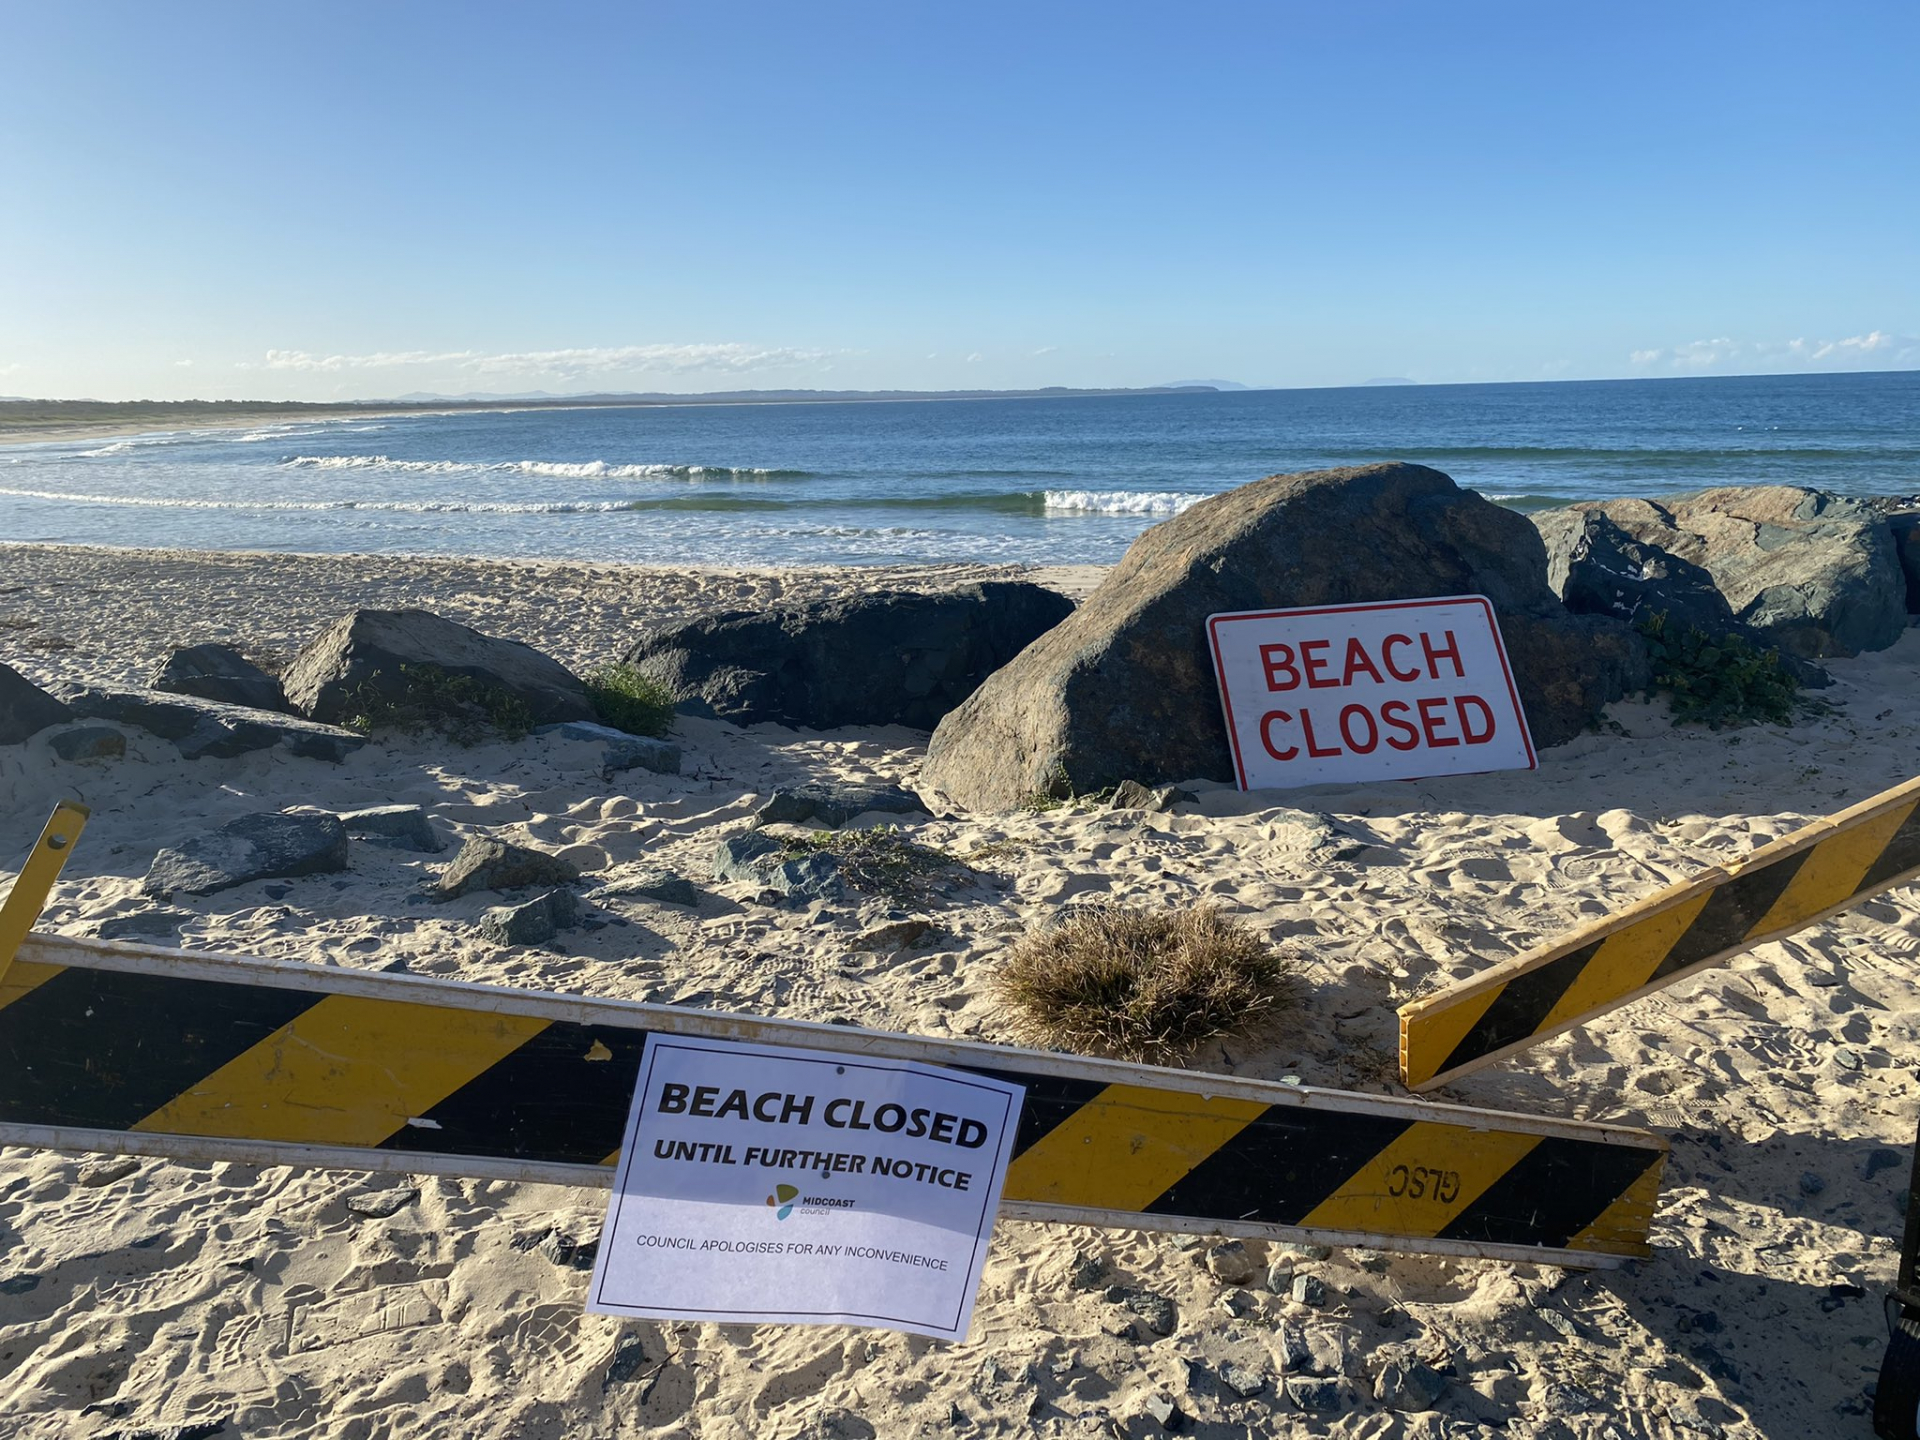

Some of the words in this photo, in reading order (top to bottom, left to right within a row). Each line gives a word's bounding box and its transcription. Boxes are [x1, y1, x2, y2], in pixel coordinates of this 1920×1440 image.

[1259, 630, 1465, 692] BEACH
[1260, 695, 1496, 761] CLOSED
[658, 1083, 815, 1125] BEACH
[823, 1098, 988, 1149] CLOSED
[653, 1139, 737, 1165] UNTIL
[743, 1147, 866, 1174] FURTHER
[870, 1157, 972, 1192] NOTICE
[1388, 1164, 1460, 1204] GLSC
[800, 1207, 831, 1216] council
[802, 1196, 856, 1208] MIDCOAST
[636, 1234, 697, 1251] COUNCIL
[699, 1239, 784, 1255] APOLOGISES
[787, 1242, 813, 1256] FOR
[814, 1243, 842, 1257] ANY
[844, 1246, 949, 1271] INCONVENIENCE
